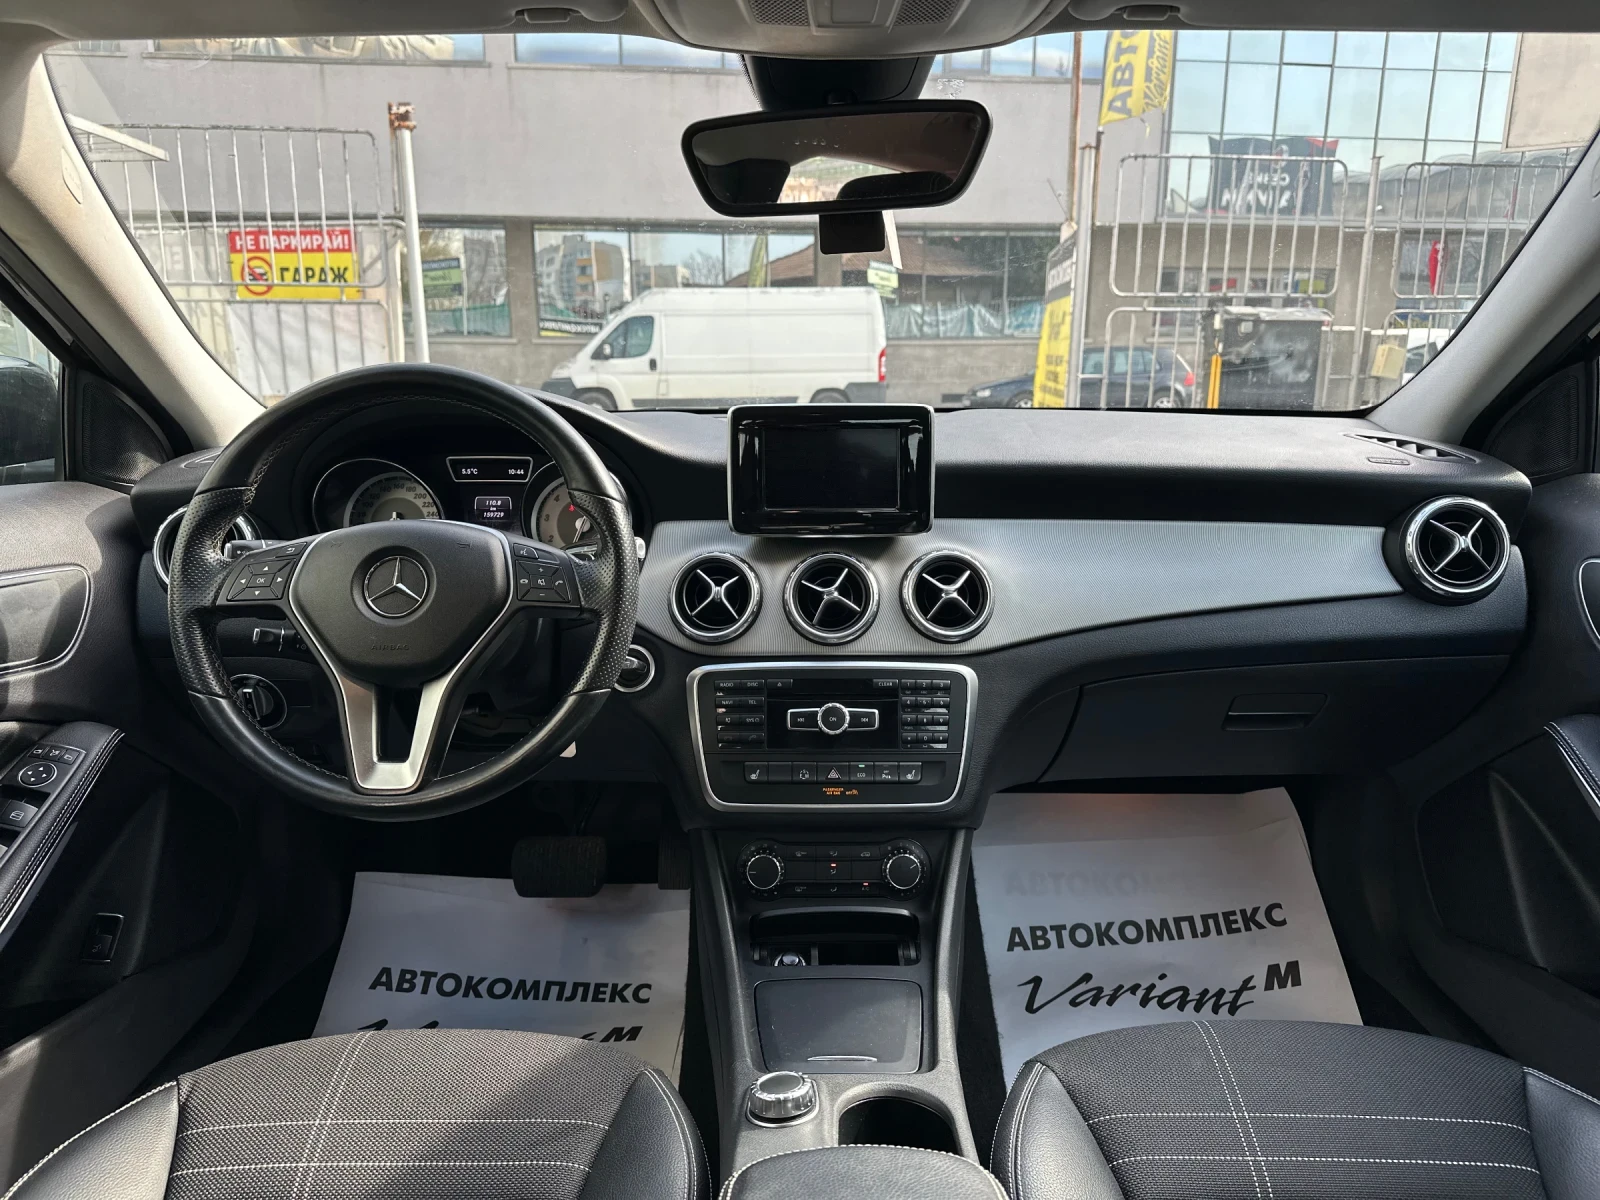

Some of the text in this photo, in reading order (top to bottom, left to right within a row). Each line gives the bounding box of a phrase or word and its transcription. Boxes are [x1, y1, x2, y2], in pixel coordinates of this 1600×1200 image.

[235, 231, 349, 250] НЕ ПАРКИРАЙ!
[279, 266, 348, 283] ГАРАЖ
[554, 494, 560, 502] 4
[544, 514, 550, 522] 3
[1006, 902, 1287, 952] АВТОКОМПЛЕКС
[368, 966, 652, 1004] АВТОКОМПЛЕКС
[1017, 972, 1256, 1016] Variant
